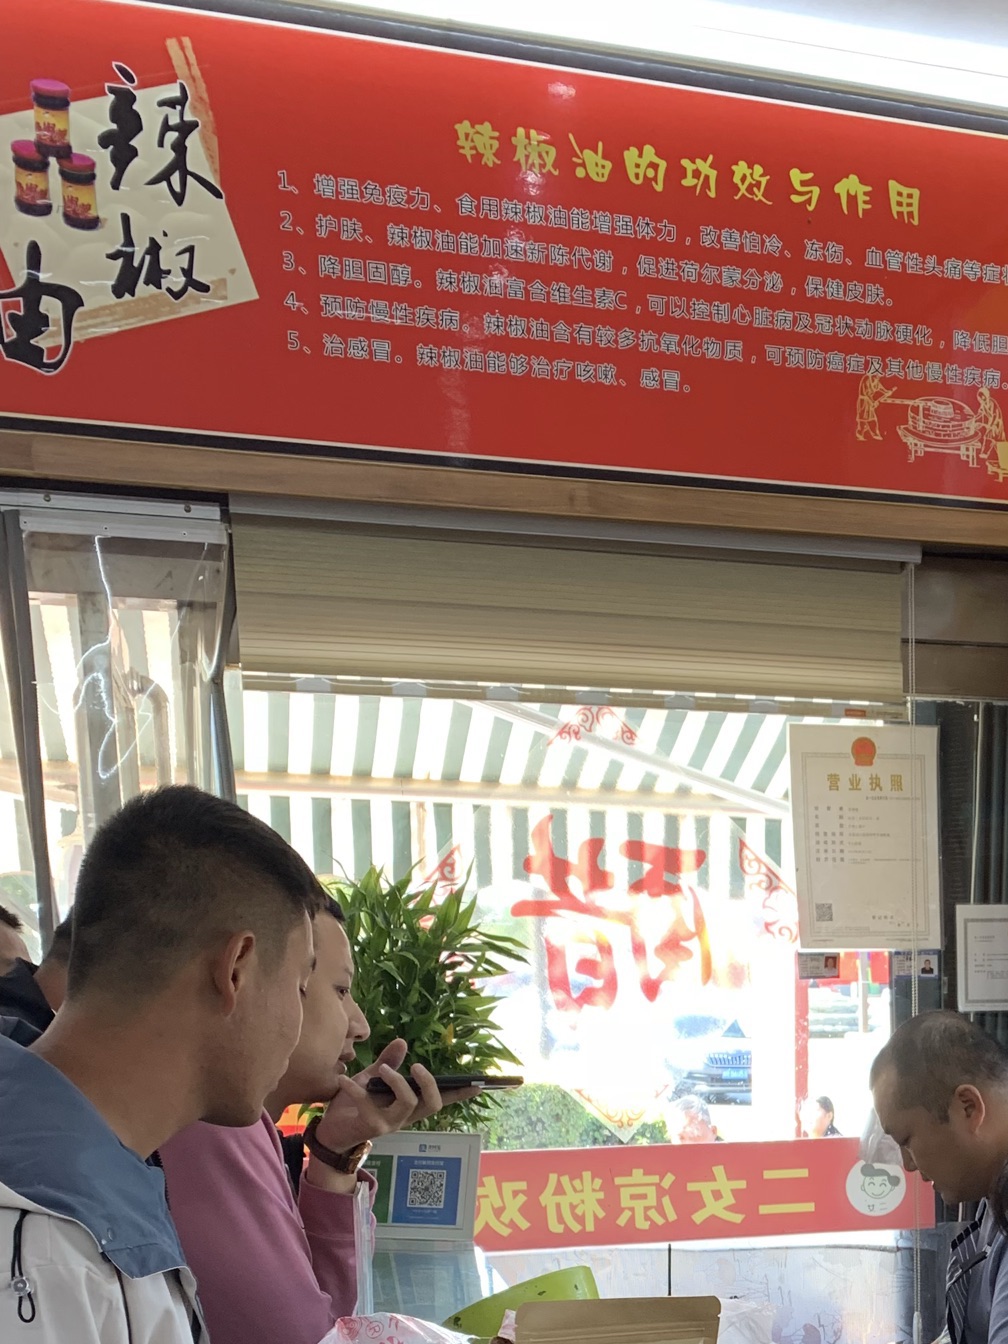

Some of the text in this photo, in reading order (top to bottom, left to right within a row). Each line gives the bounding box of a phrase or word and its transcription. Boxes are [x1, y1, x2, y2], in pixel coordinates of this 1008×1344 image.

[455, 117, 923, 229] 辣椒油的功效与作用
[826, 773, 904, 792] 营业执照
